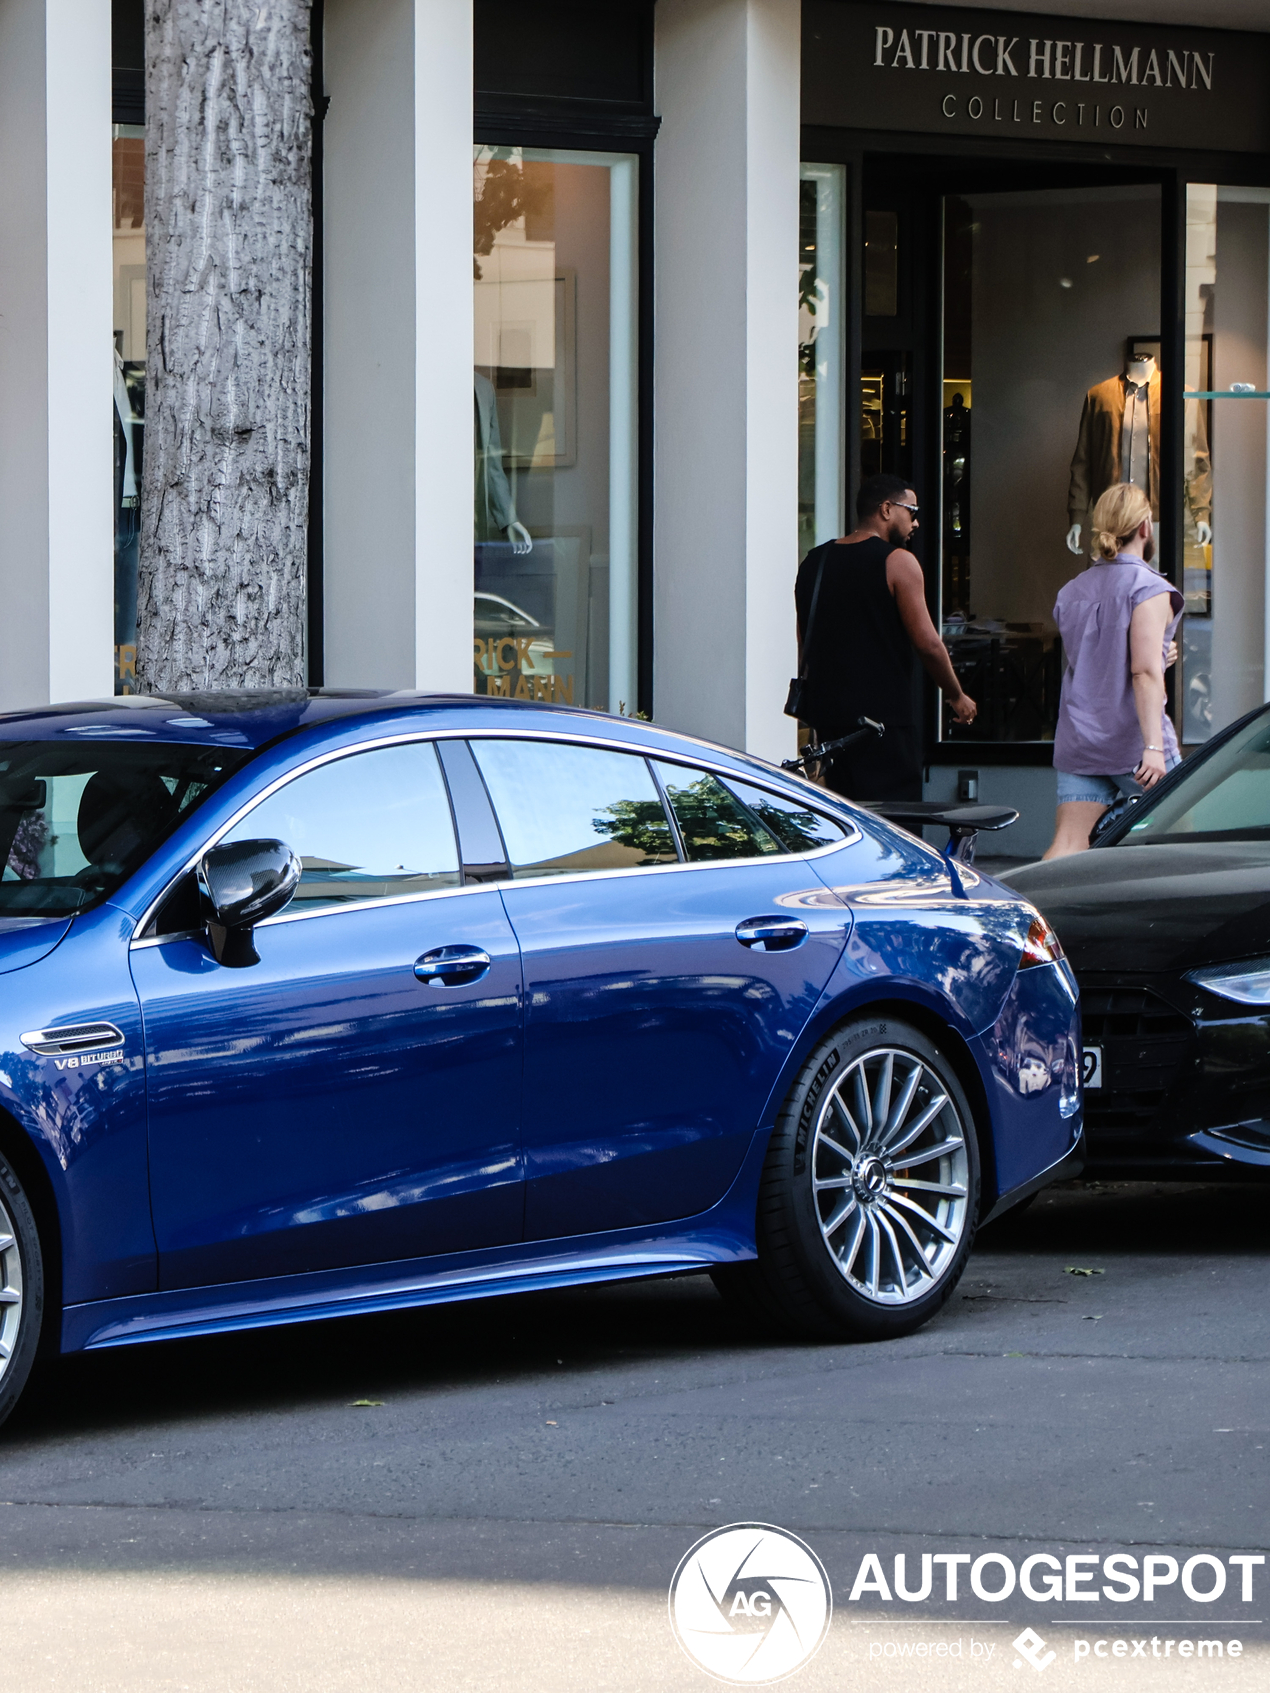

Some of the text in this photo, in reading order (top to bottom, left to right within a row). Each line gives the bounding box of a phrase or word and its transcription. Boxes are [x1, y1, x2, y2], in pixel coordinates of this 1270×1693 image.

[873, 26, 1215, 90] PATRICK HELLMANN
[942, 94, 1148, 129] COLLECTION
[474, 674, 573, 704] MANN
[54, 1057, 79, 1071] V8
[80, 1049, 123, 1065] BITURBO
[1083, 1051, 1097, 1084] 9
[797, 1051, 838, 1146] MICHELIN
